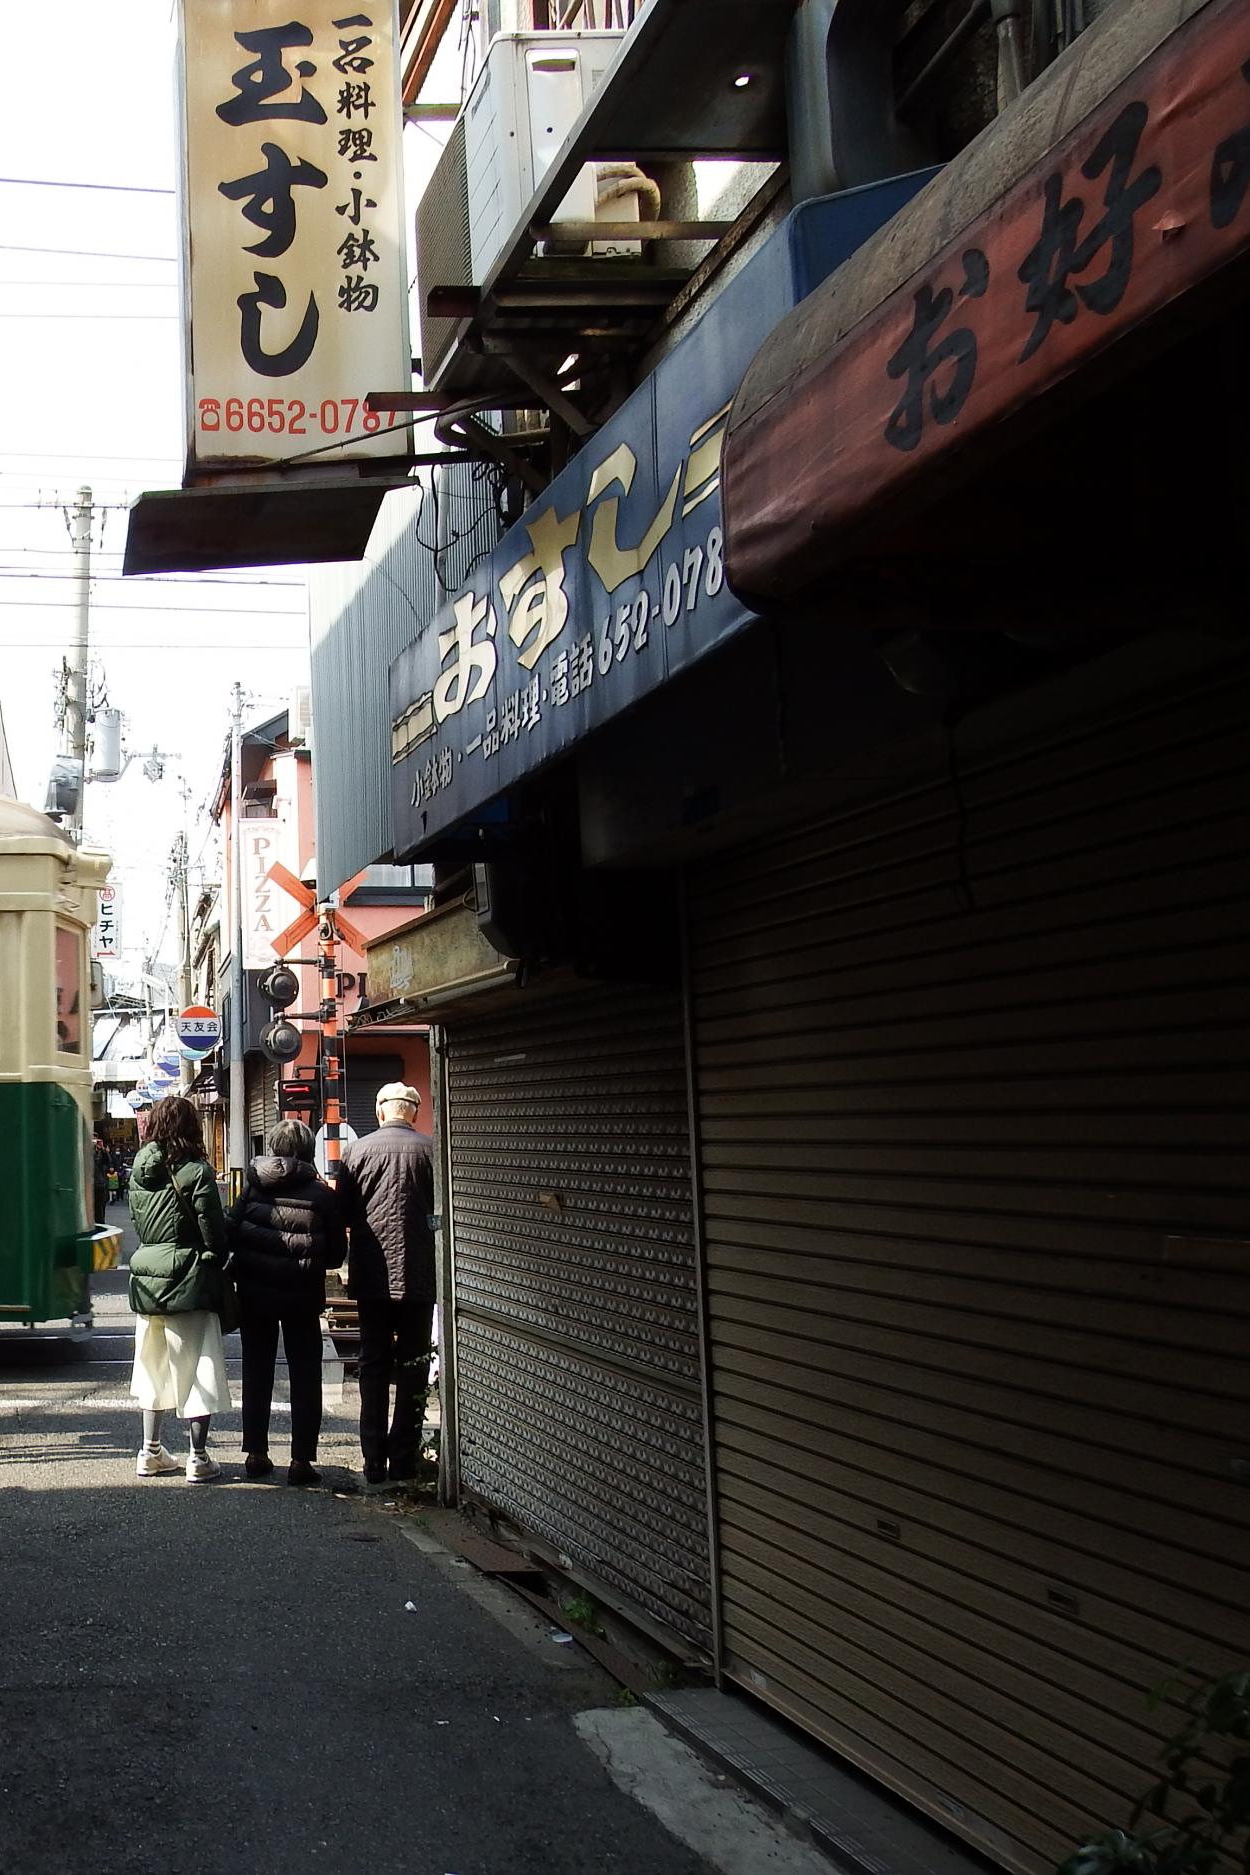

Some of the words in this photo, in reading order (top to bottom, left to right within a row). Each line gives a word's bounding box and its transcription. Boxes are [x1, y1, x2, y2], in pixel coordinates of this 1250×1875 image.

[215, 20, 329, 378] 玉すし
[433, 442, 684, 725] おすし
[598, 526, 723, 676] 652-078
[98, 903, 115, 949] ヒチヤ
[252, 837, 274, 932] PIZZA
[180, 1021, 219, 1033] 天友会
